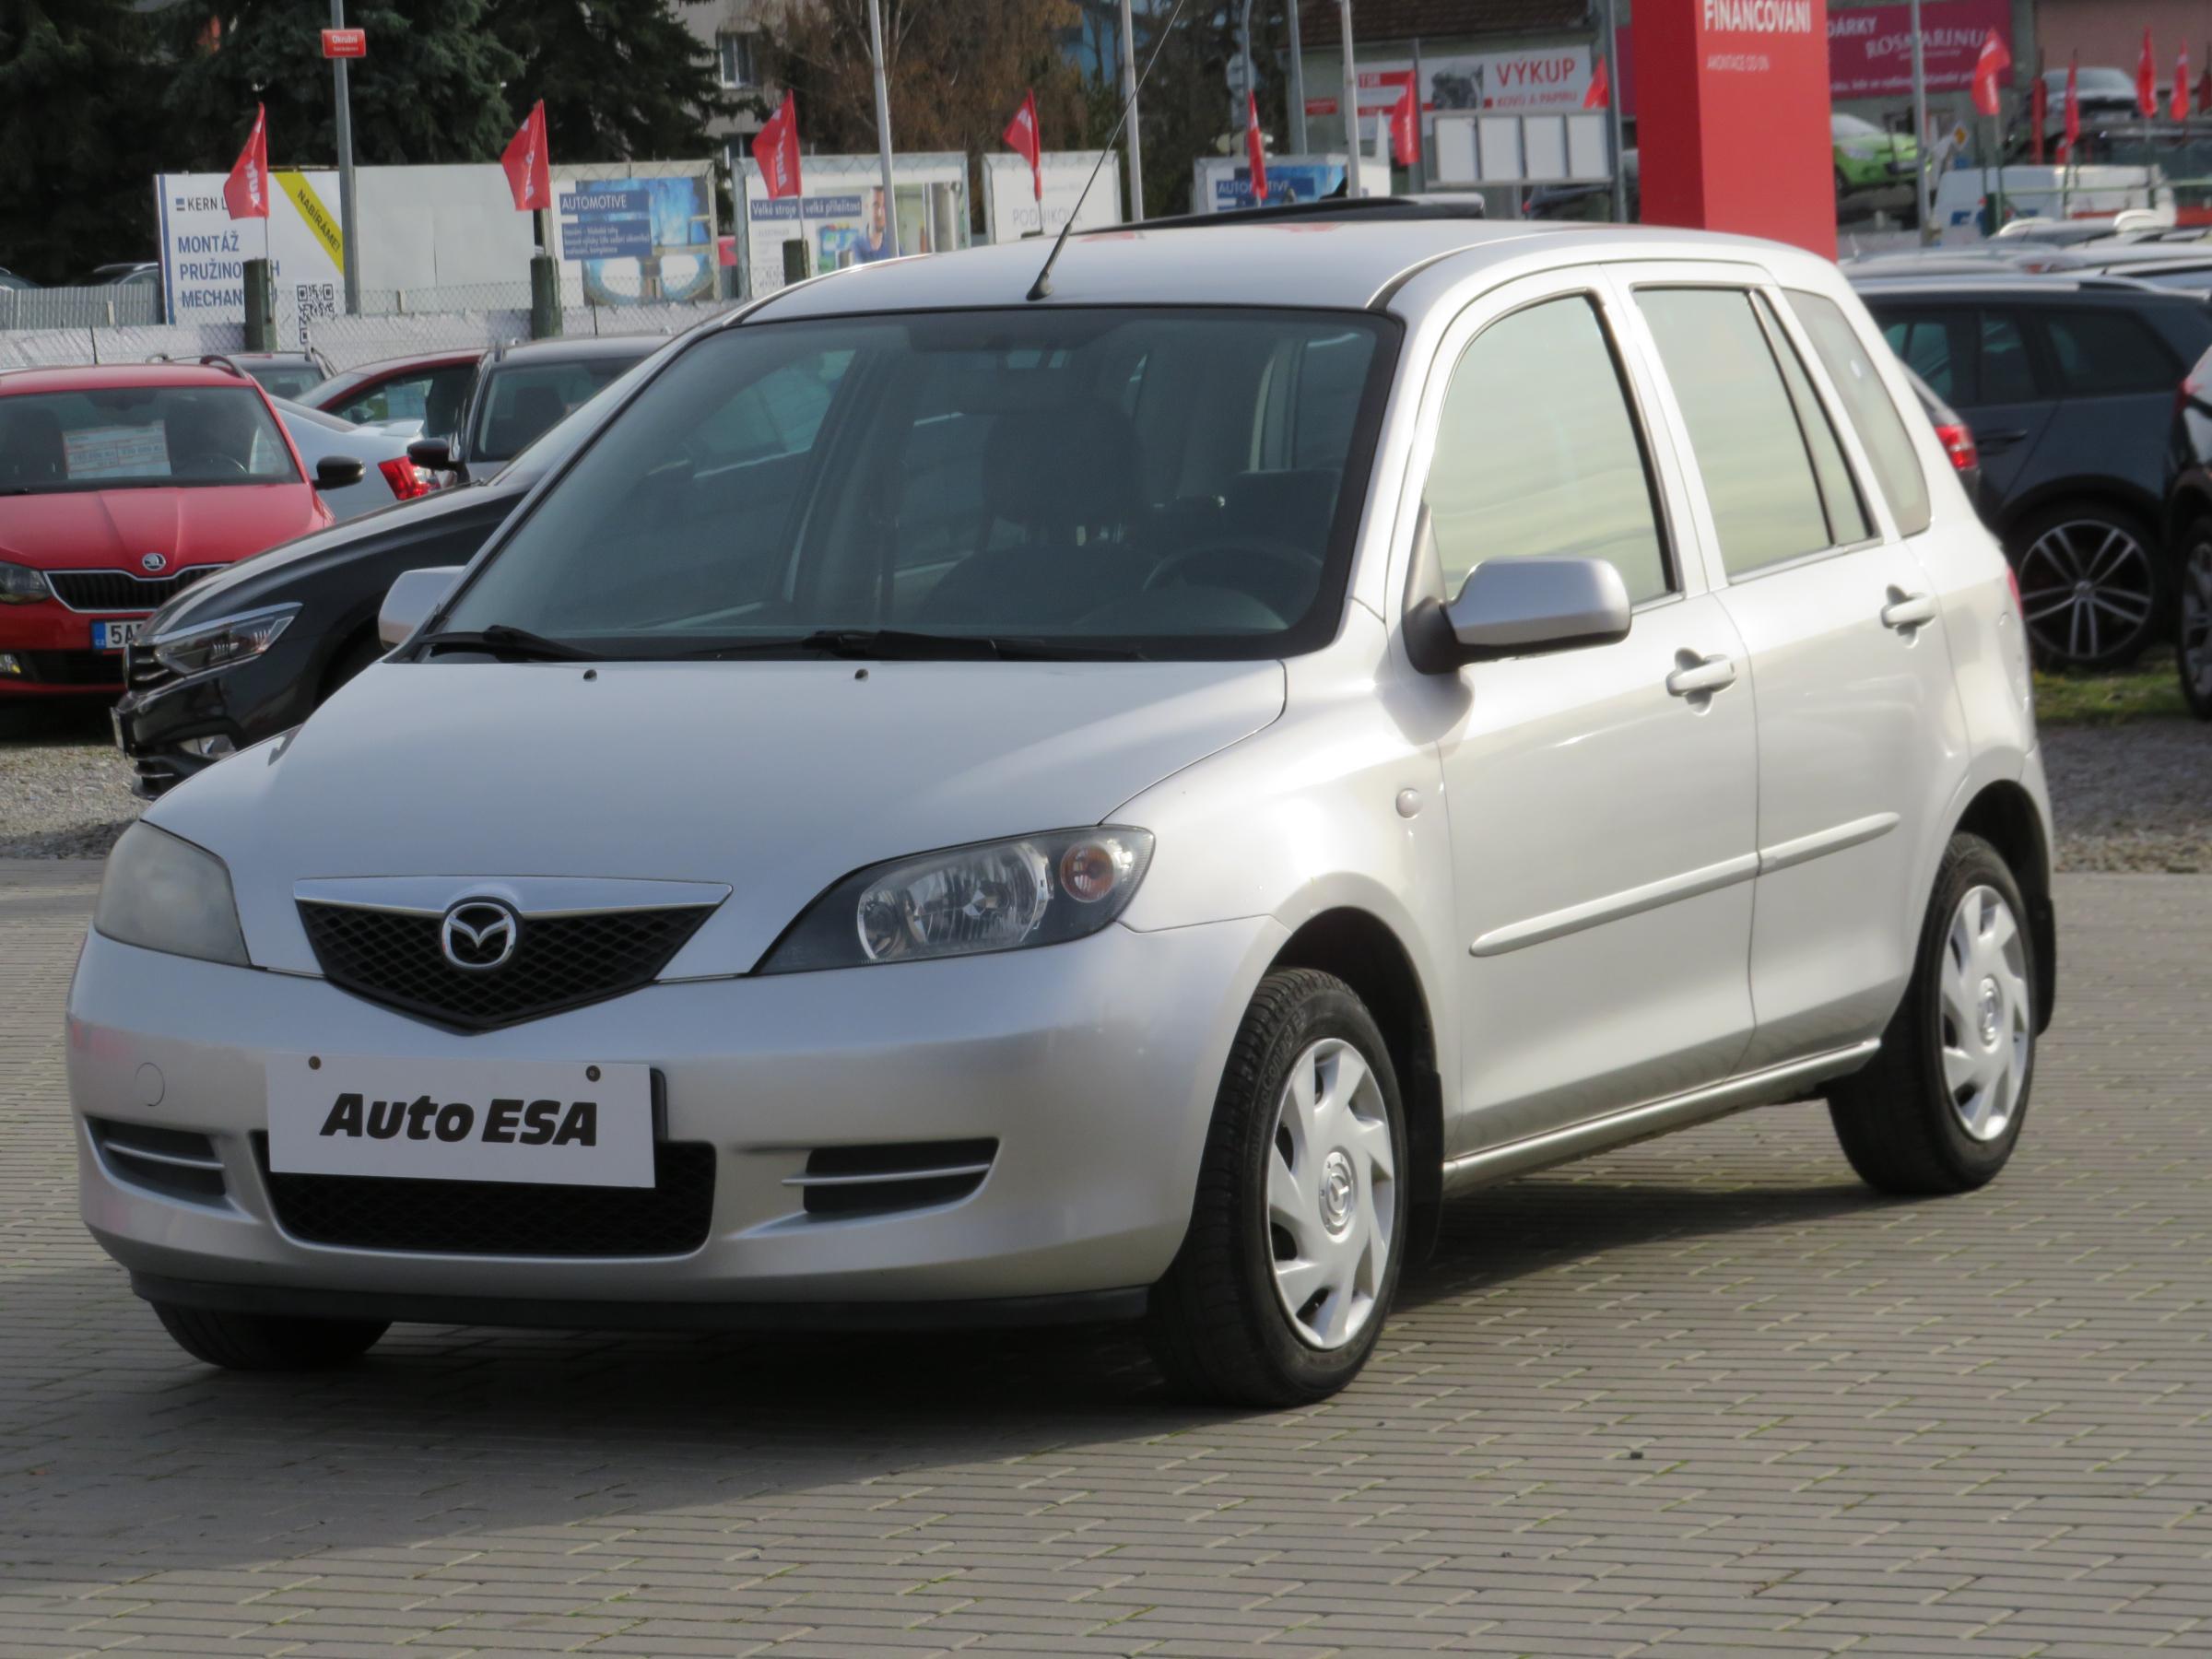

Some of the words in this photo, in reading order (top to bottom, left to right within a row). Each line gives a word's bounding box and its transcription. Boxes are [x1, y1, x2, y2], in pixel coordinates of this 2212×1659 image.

[1496, 56, 1575, 88] VÝKUP
[187, 196, 218, 211] KERN
[561, 194, 627, 210] AUTOMOTIVE
[178, 229, 240, 253] MONTÁŽ
[180, 258, 280, 280] PRUŽINOH
[319, 1093, 475, 1143] Auto
[481, 1099, 597, 1147] ESA
